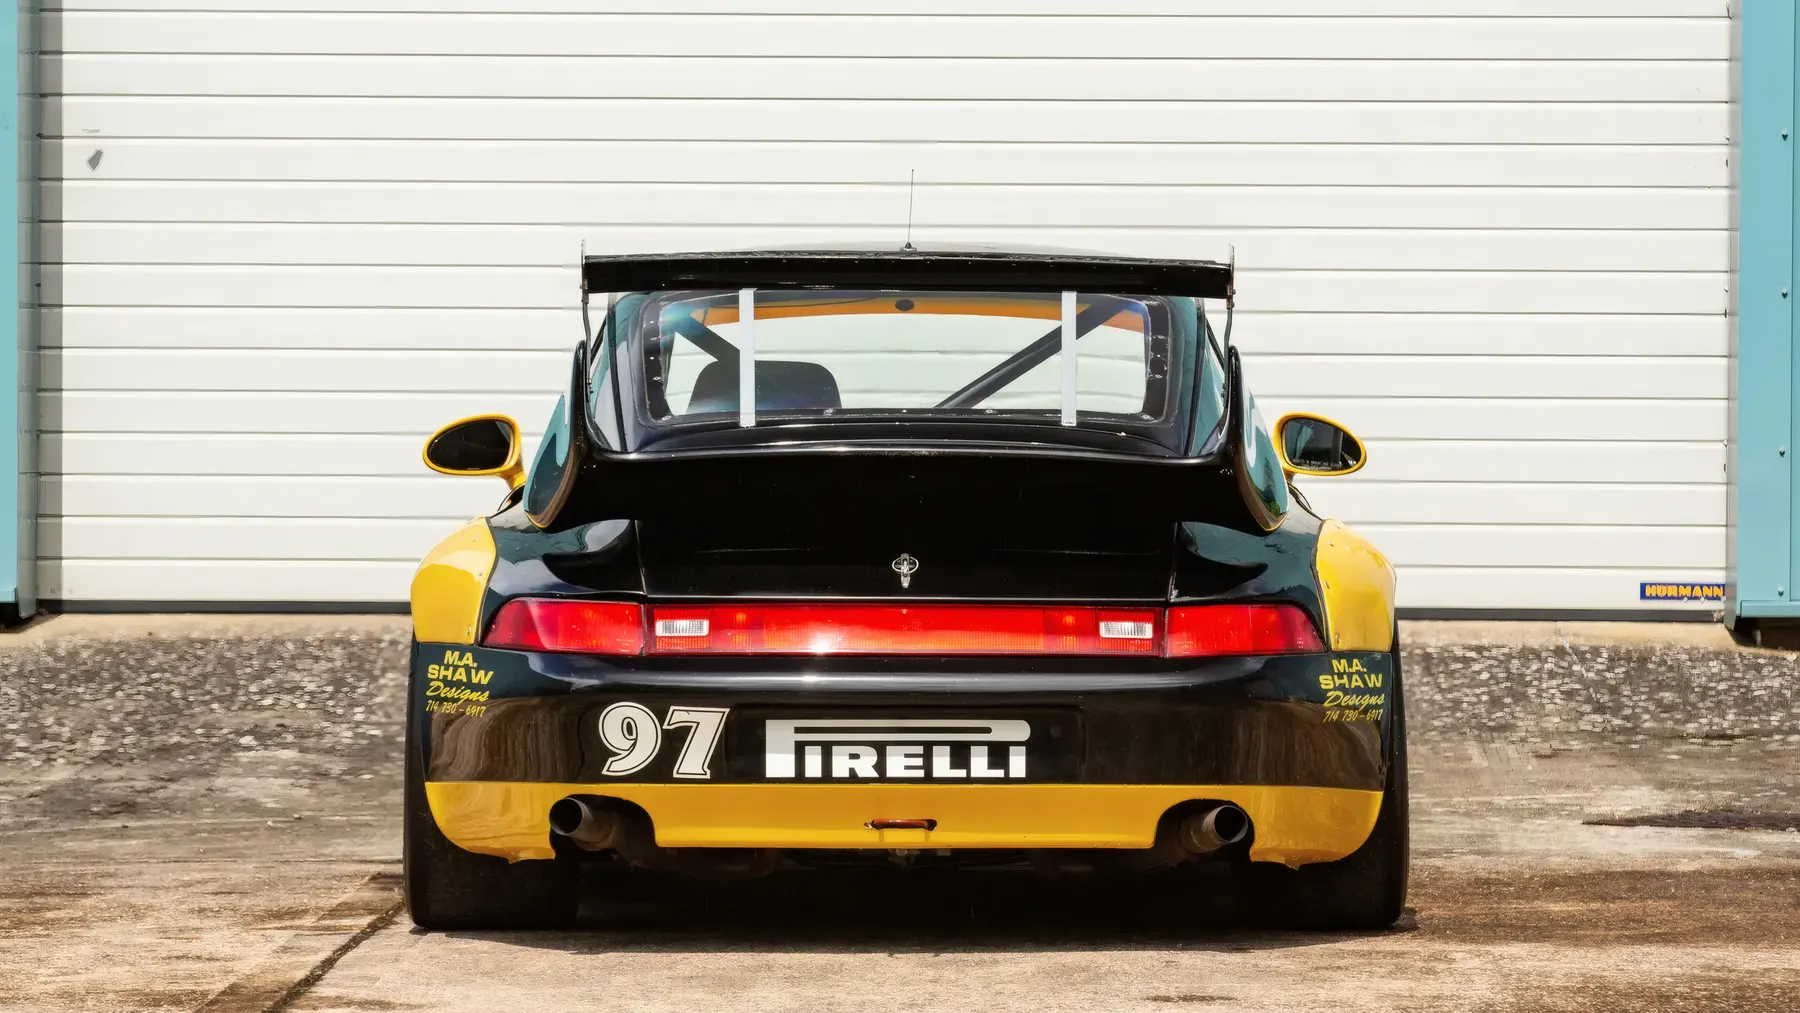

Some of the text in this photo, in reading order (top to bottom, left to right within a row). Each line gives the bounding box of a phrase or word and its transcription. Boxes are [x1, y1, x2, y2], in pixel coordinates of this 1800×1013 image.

[443, 650, 478, 668] M.A.
[1331, 658, 1367, 673] M.A.
[427, 664, 494, 685] SHAW
[1319, 673, 1383, 690] SHAW
[426, 680, 490, 705] Designs
[1323, 690, 1385, 711] Designs
[425, 699, 440, 712] 714
[1323, 710, 1340, 723] 714
[598, 701, 730, 779] 97
[765, 719, 1031, 778] PIRELLI
